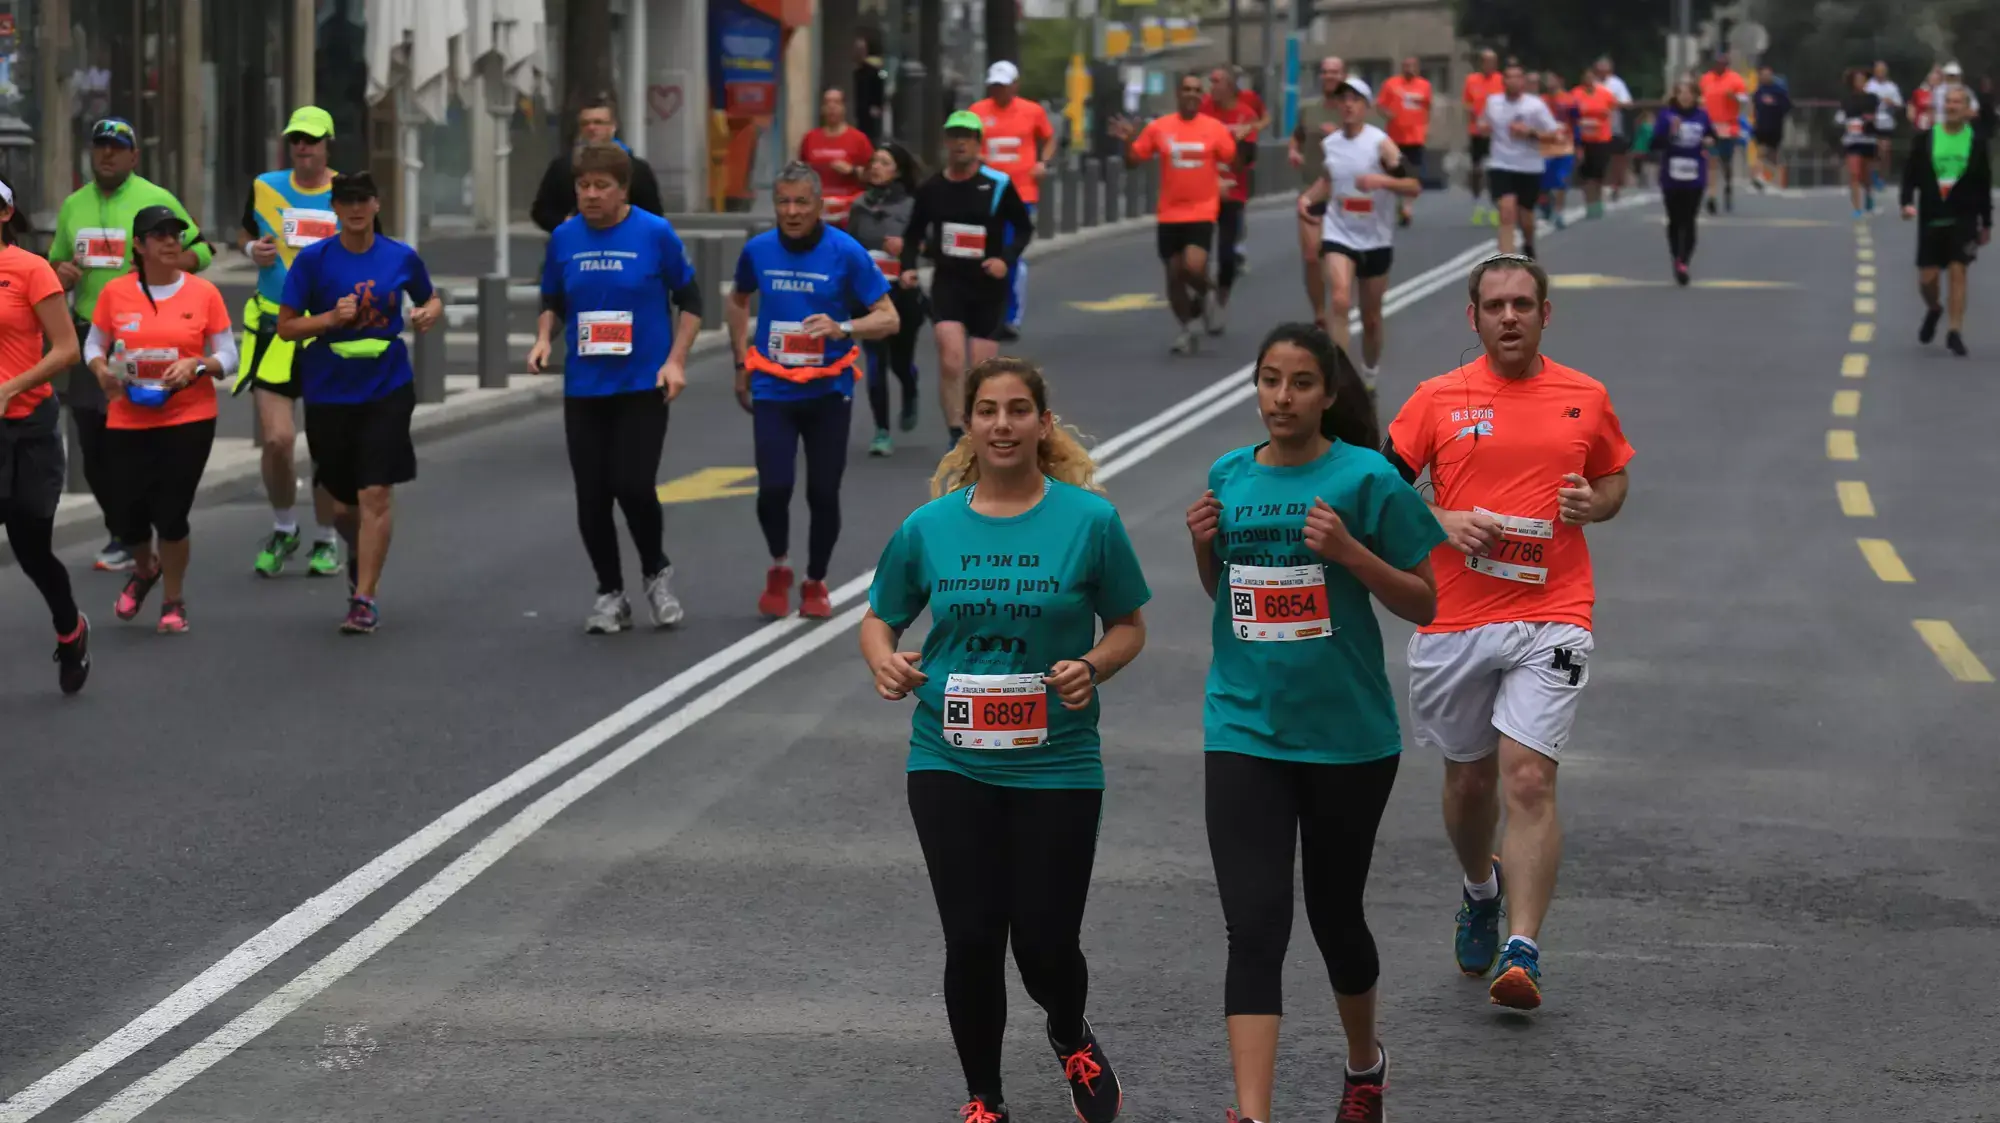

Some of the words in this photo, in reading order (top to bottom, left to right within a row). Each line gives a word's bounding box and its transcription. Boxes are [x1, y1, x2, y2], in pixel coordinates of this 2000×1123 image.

[580, 259, 623, 272] ITALIA
[772, 279, 814, 293] ITALIA
[1451, 408, 1494, 422] 18.32016
[1235, 505, 1253, 522] רץ
[1257, 503, 1282, 517] אני
[1286, 503, 1307, 516] גם
[1500, 540, 1544, 563] 7786
[960, 554, 981, 571] רץ
[986, 554, 1013, 567] אני
[1018, 554, 1040, 567] גם
[1471, 557, 1479, 569] B
[938, 578, 1010, 593] משפחות
[1016, 576, 1060, 595] למען
[950, 598, 997, 620] לכתף
[1004, 603, 1042, 620] כתף
[1264, 593, 1318, 618] 6854
[1240, 625, 1248, 639] C
[983, 701, 1037, 725] 6897
[953, 732, 962, 746] C
